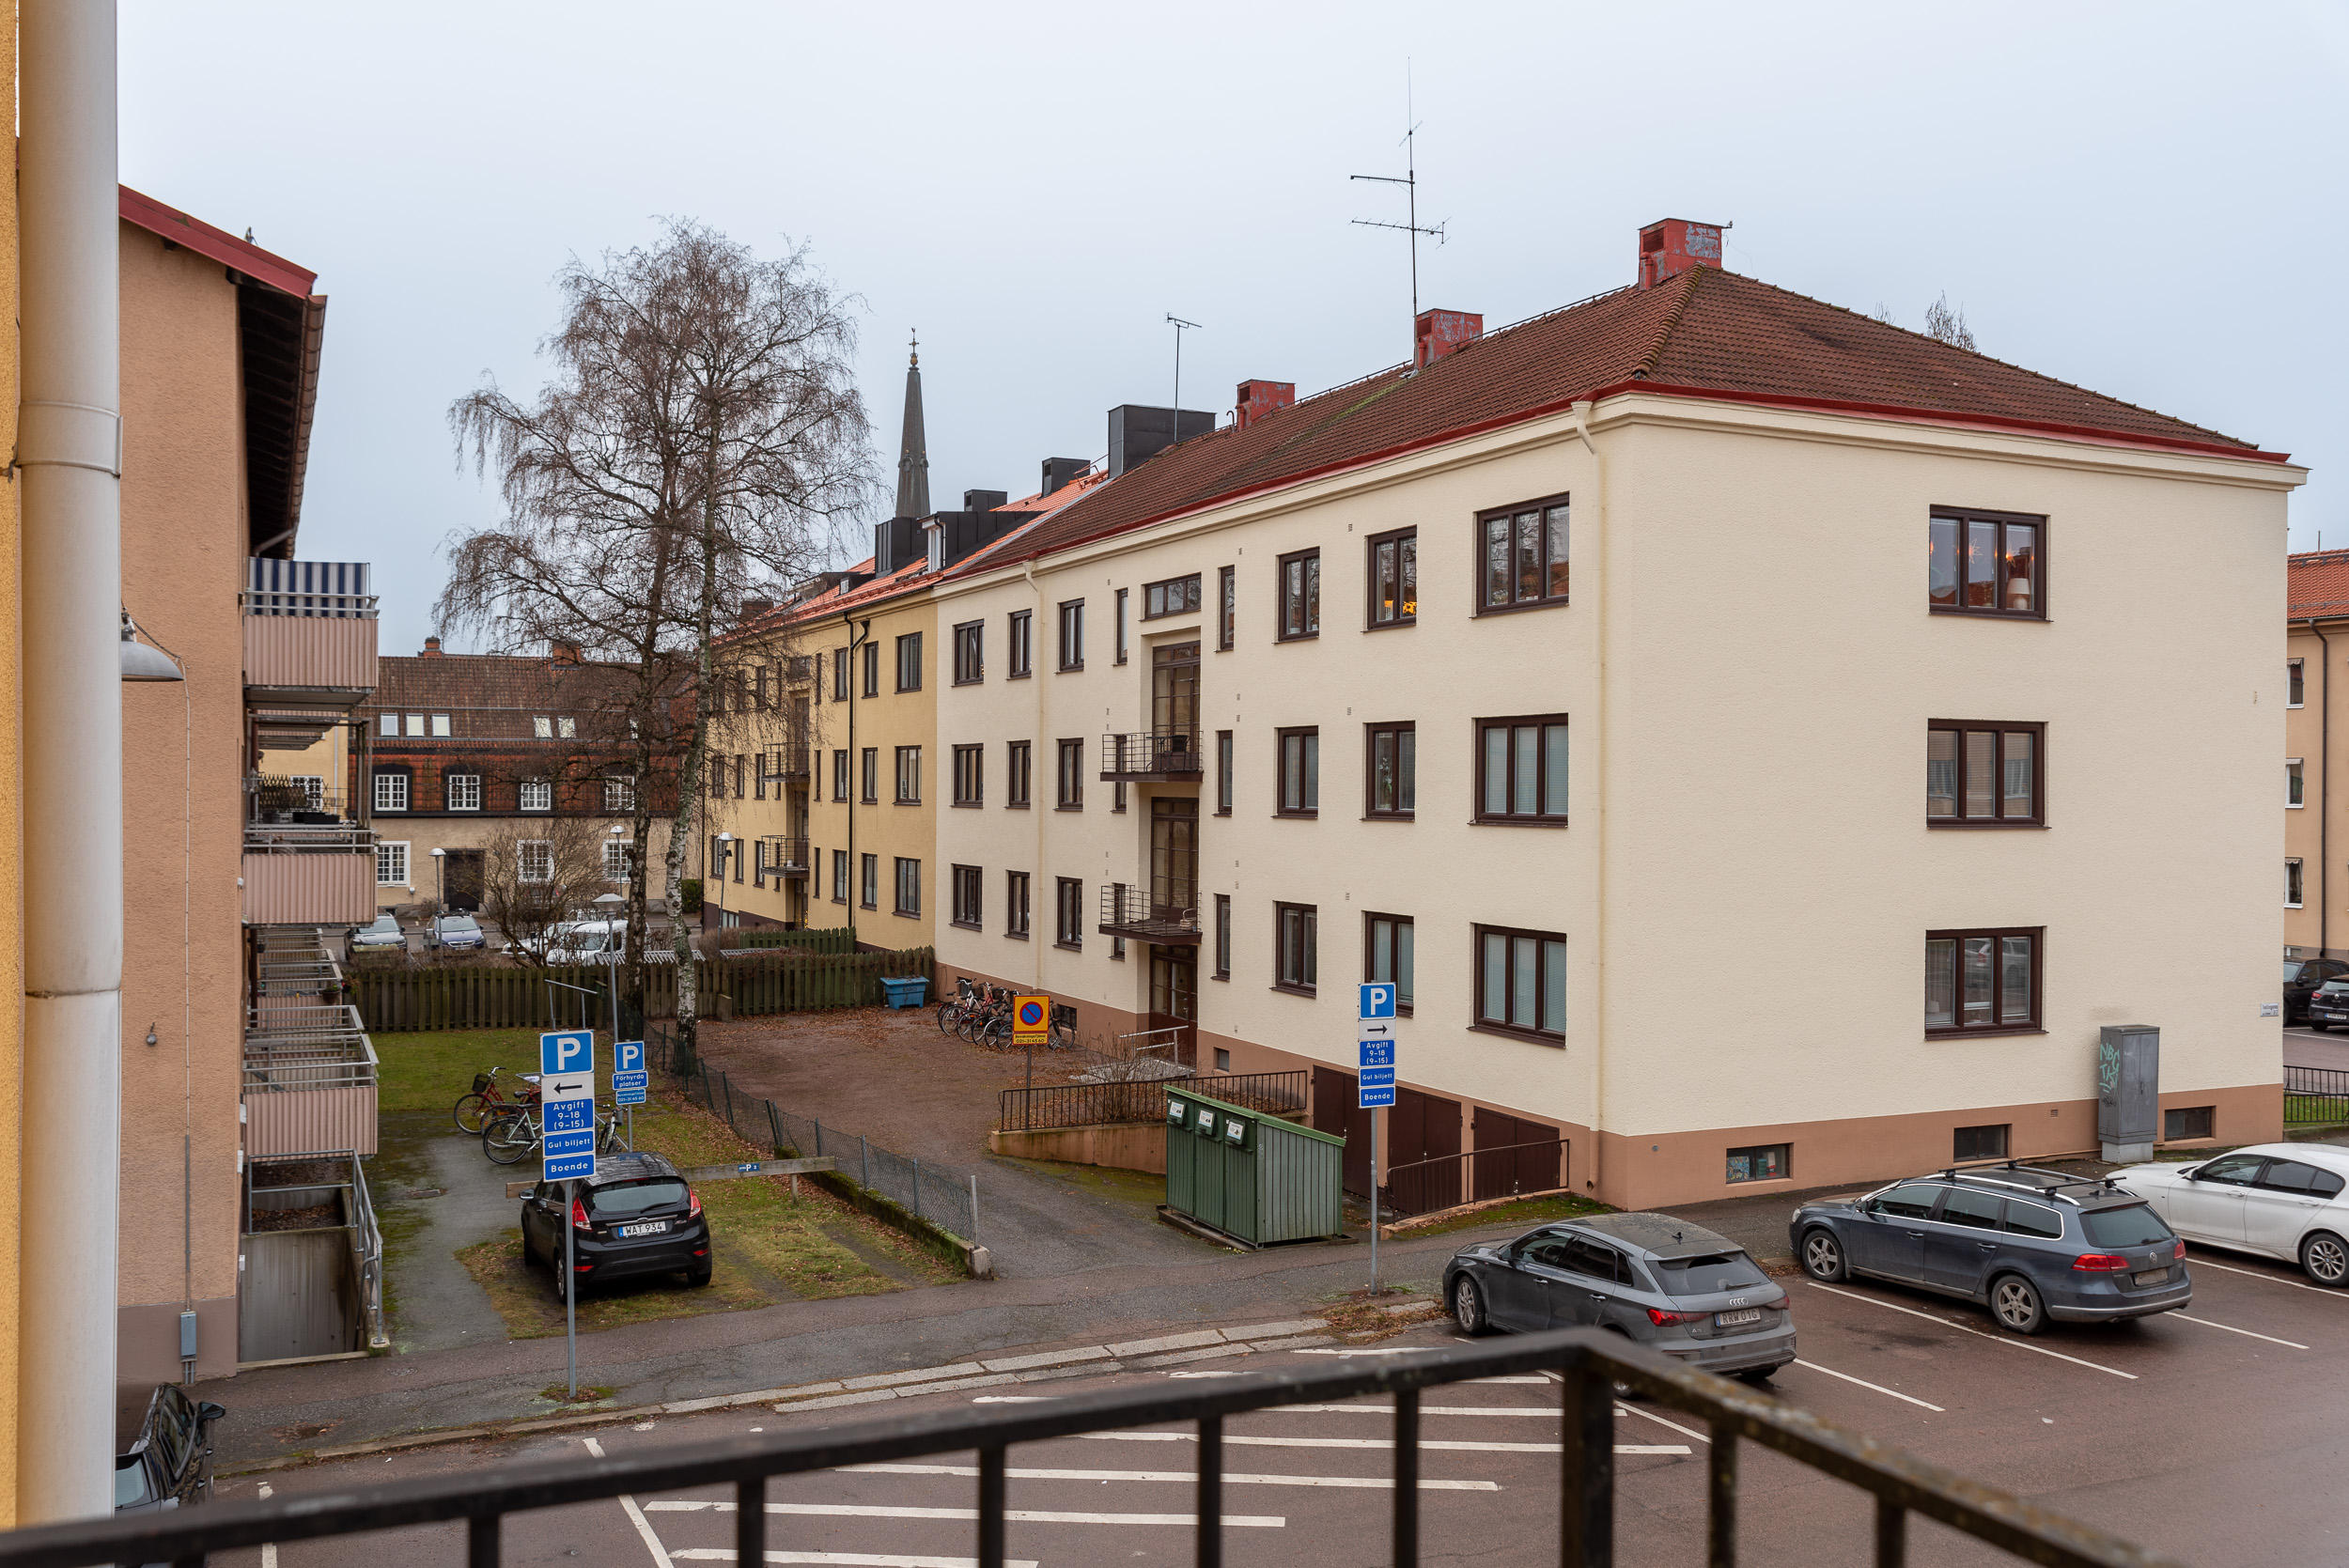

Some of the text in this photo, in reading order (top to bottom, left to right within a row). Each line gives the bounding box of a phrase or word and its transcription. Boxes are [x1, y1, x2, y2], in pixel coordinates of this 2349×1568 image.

[1370, 987, 1388, 1016] P
[1366, 1041, 1389, 1050] Avgift
[557, 1037, 581, 1070] P
[622, 1045, 639, 1069] P
[1364, 1093, 1391, 1101] Boende
[552, 1101, 584, 1111] Avgift
[557, 1111, 581, 1120] 9-18
[553, 1119, 584, 1130] (9-15)
[548, 1139, 591, 1149] Gul biljett
[551, 1161, 589, 1173] Boende
[625, 1225, 643, 1235] WAT
[645, 1222, 662, 1233] 934
[1721, 1312, 1739, 1324] RRW
